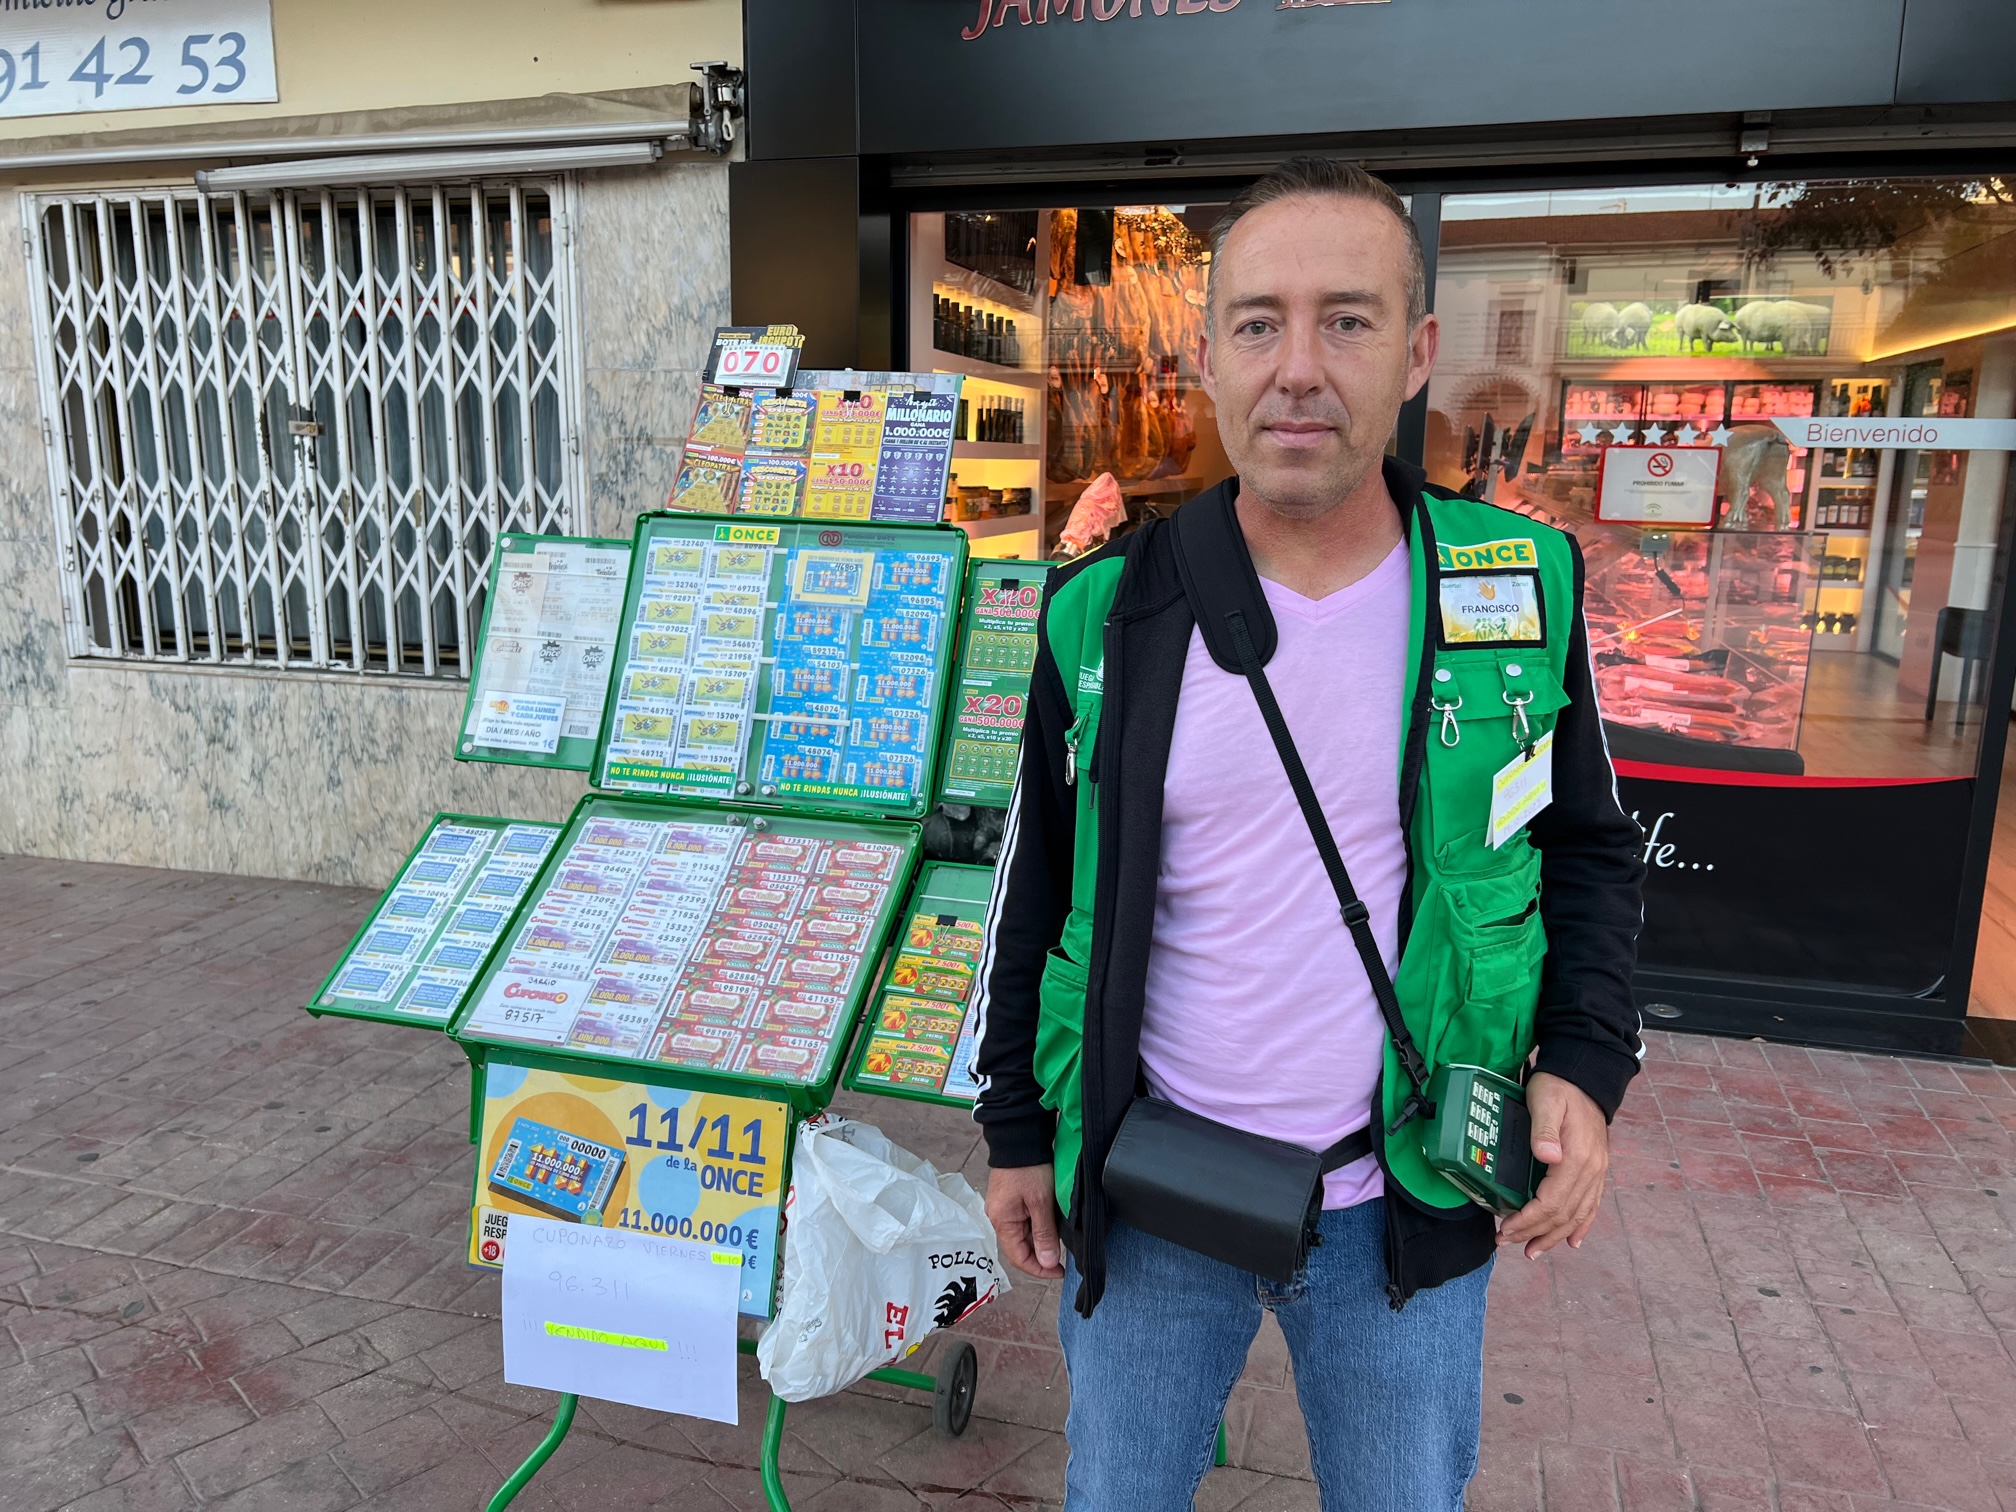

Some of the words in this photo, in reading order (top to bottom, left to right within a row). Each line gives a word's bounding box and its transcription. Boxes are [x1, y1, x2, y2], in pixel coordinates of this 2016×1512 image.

[67, 35, 154, 99] 42
[176, 31, 246, 95] 53
[723, 351, 780, 374] 070
[886, 408, 952, 422] MILLONARIO
[885, 427, 950, 438] 1.000.000€
[1807, 423, 1938, 443] Bienvenido
[827, 463, 864, 477] x10
[733, 529, 775, 541] ONCE
[916, 554, 941, 563] 96895
[1455, 544, 1530, 567] ONCE
[675, 581, 698, 589] 32740
[910, 597, 935, 605] 96895
[978, 587, 1037, 607] x20
[733, 608, 757, 616] 40396
[1461, 604, 1520, 614] FRANCISCO
[979, 618, 1006, 626] Multiplica
[665, 625, 689, 633] 07022
[732, 641, 756, 649] 54687
[728, 653, 752, 661] 21958
[899, 653, 925, 662] 82094
[816, 660, 840, 669] 54103
[658, 666, 683, 674] 48712
[724, 670, 747, 678] 15709
[900, 667, 926, 675] 07326
[535, 706, 556, 714] LUNES
[814, 705, 839, 713] 48074
[962, 695, 1022, 716] x20
[650, 707, 674, 715] 48712
[716, 712, 740, 720] 15709
[894, 709, 919, 718] 07326
[516, 712, 534, 720] CADA
[535, 714, 559, 722] JUEVES
[503, 728, 519, 736] MES
[524, 730, 541, 738] AÑO
[962, 727, 990, 735] Multiplica
[543, 739, 555, 750] 1€
[640, 750, 664, 758] 48712
[806, 747, 831, 756] 48074
[709, 755, 733, 763] 15709
[888, 755, 914, 763] 07326
[610, 767, 620, 775] NO
[622, 768, 631, 776] TE
[632, 769, 658, 778] RINDAS
[661, 771, 685, 780] NUNCA
[687, 772, 733, 784] ¡ILUSIÓNATE!
[780, 783, 791, 791] NO
[793, 784, 801, 792] TE
[803, 785, 831, 795] RINDAS
[833, 787, 858, 796] NUNCA
[860, 789, 908, 801] ¡ILUSIÓNATE!
[629, 821, 657, 829] 82930
[708, 826, 736, 836] 91543
[787, 838, 812, 846] 13531
[613, 849, 642, 858] 36271
[603, 865, 632, 874] 06402
[692, 863, 720, 872] 91543
[686, 874, 715, 884] 21764
[772, 874, 797, 882] 13531
[769, 883, 795, 891] 05042
[853, 881, 880, 889] 29658
[588, 895, 617, 905] 17092
[678, 895, 707, 905] 67395
[671, 910, 700, 920] 71856
[839, 914, 866, 922] 34959
[572, 921, 602, 930] 54618
[665, 923, 694, 933] 15327
[752, 921, 779, 930] 05042
[657, 934, 688, 944] 45389
[823, 953, 851, 962] 41165
[550, 961, 580, 972] 54618
[638, 973, 669, 983] 45389
[728, 973, 756, 982] 62884
[722, 985, 750, 995] 98198
[806, 994, 836, 1004] 41165
[618, 1014, 649, 1024] 45389
[705, 1028, 733, 1038] 98198
[790, 1038, 820, 1048] 41165
[626, 1102, 766, 1165] 11/11
[570, 1140, 607, 1160] 00000
[666, 1155, 680, 1168] de
[684, 1157, 698, 1171] la
[513, 1178, 533, 1190] ONCE
[700, 1165, 765, 1198] ONCE
[484, 1244, 497, 1257] +18
[533, 1227, 626, 1250] CUPONAZO
[643, 1241, 706, 1261] VIERNES
[712, 1253, 740, 1265] 14-10
[928, 1251, 994, 1274] POLLOS
[548, 1270, 629, 1301] 96.311
[885, 1302, 909, 1349] EL
[546, 1324, 609, 1344] VENDIDO
